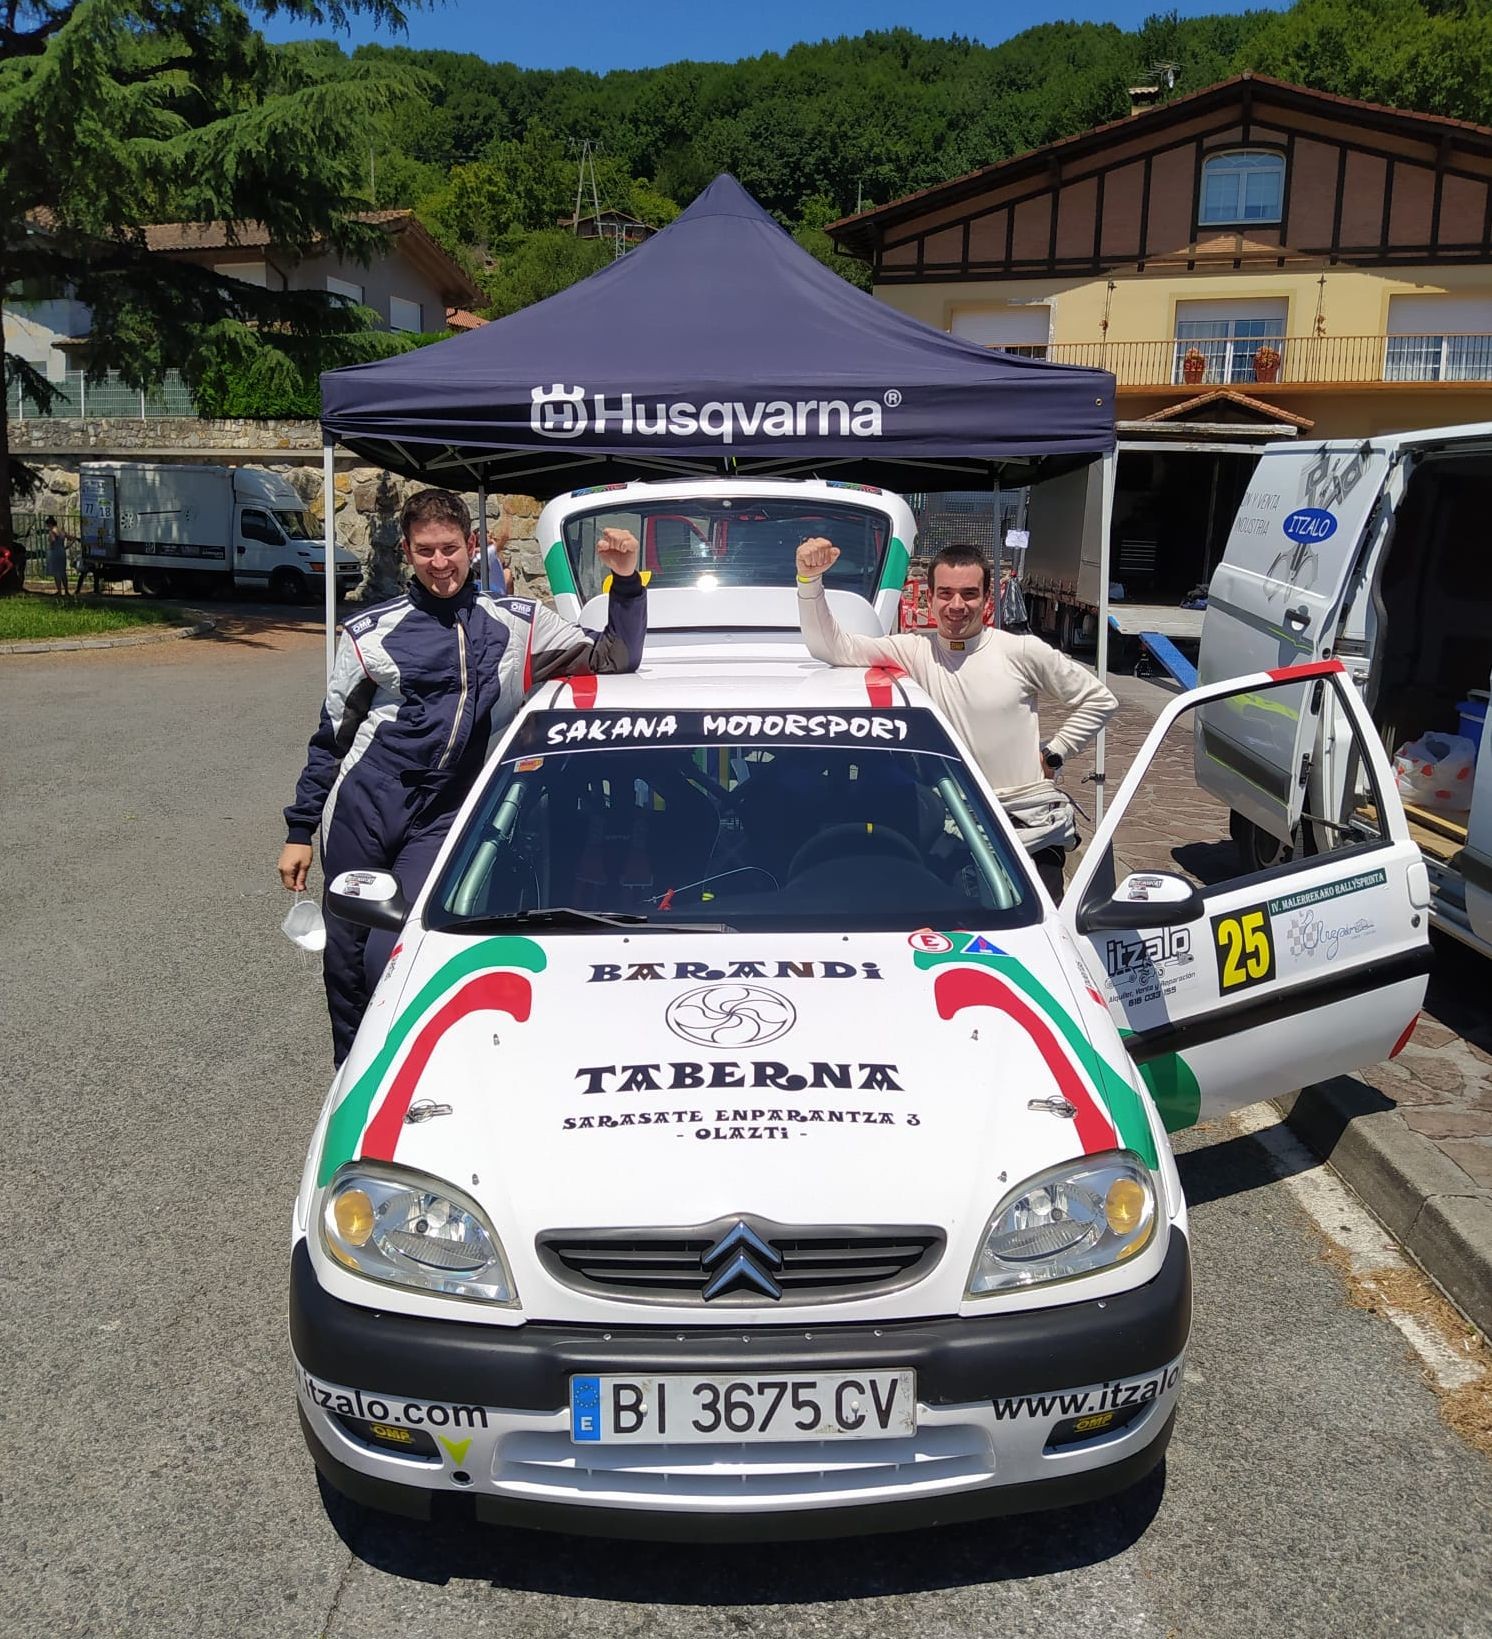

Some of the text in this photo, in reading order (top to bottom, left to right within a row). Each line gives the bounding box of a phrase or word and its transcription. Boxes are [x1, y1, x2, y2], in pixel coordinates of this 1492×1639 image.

[100, 507, 111, 518] 18
[1288, 515, 1331, 538] ITZALO
[510, 602, 532, 615] OMP
[352, 616, 373, 633] OMP
[547, 714, 907, 745] SAKANA MOTORSPORT
[1282, 887, 1335, 910] MALERREKAKO
[1106, 925, 1191, 977] itzalo
[1217, 911, 1271, 988] 25
[574, 1061, 906, 1095] TABERNA
[562, 1109, 921, 1130] SARASATE ENPARANTZA 3
[580, 1379, 899, 1434] E BI 3675 CV
[1076, 1414, 1113, 1430] OMP
[373, 1426, 411, 1442] OMP
